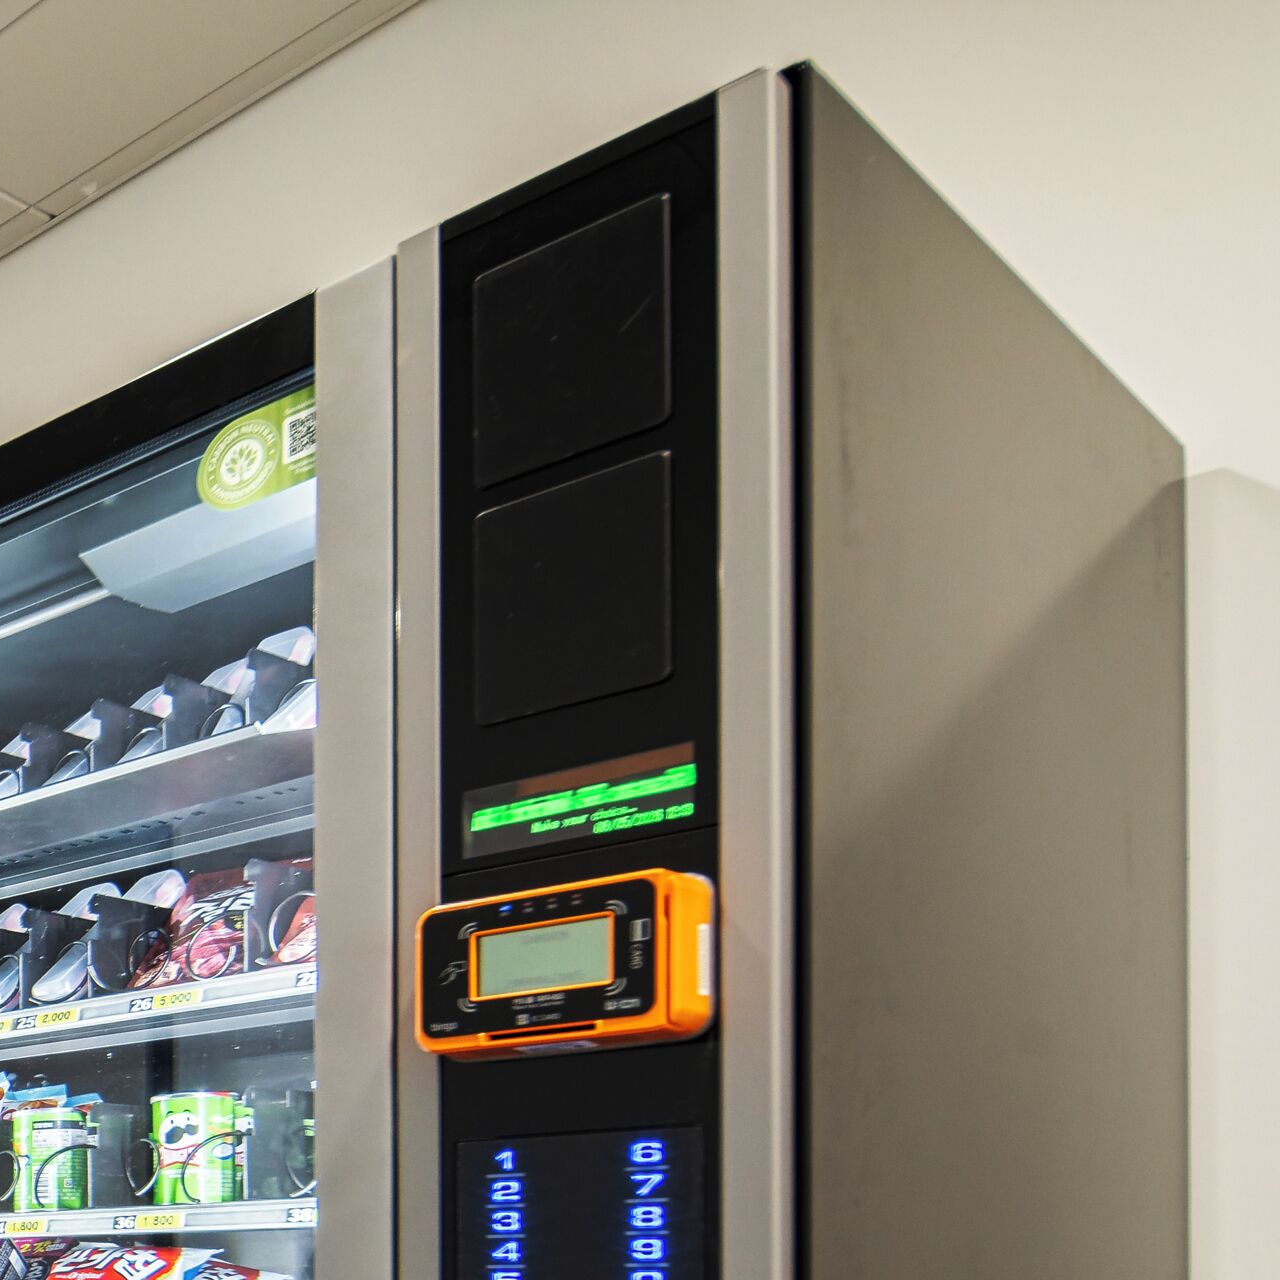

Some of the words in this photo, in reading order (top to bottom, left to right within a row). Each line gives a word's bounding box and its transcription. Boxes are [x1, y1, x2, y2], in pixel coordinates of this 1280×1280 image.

[130, 999, 152, 1012] 26
[16, 1018, 35, 1029] 25
[494, 1150, 515, 1170] 1
[630, 1141, 664, 1163] 6
[491, 1181, 521, 1201] 2
[630, 1173, 665, 1196] 7
[113, 1217, 134, 1228] 36
[289, 1208, 314, 1222] 38
[491, 1211, 521, 1231] 3
[631, 1206, 664, 1227] 8
[491, 1241, 521, 1261] 4
[631, 1238, 664, 1260] 9
